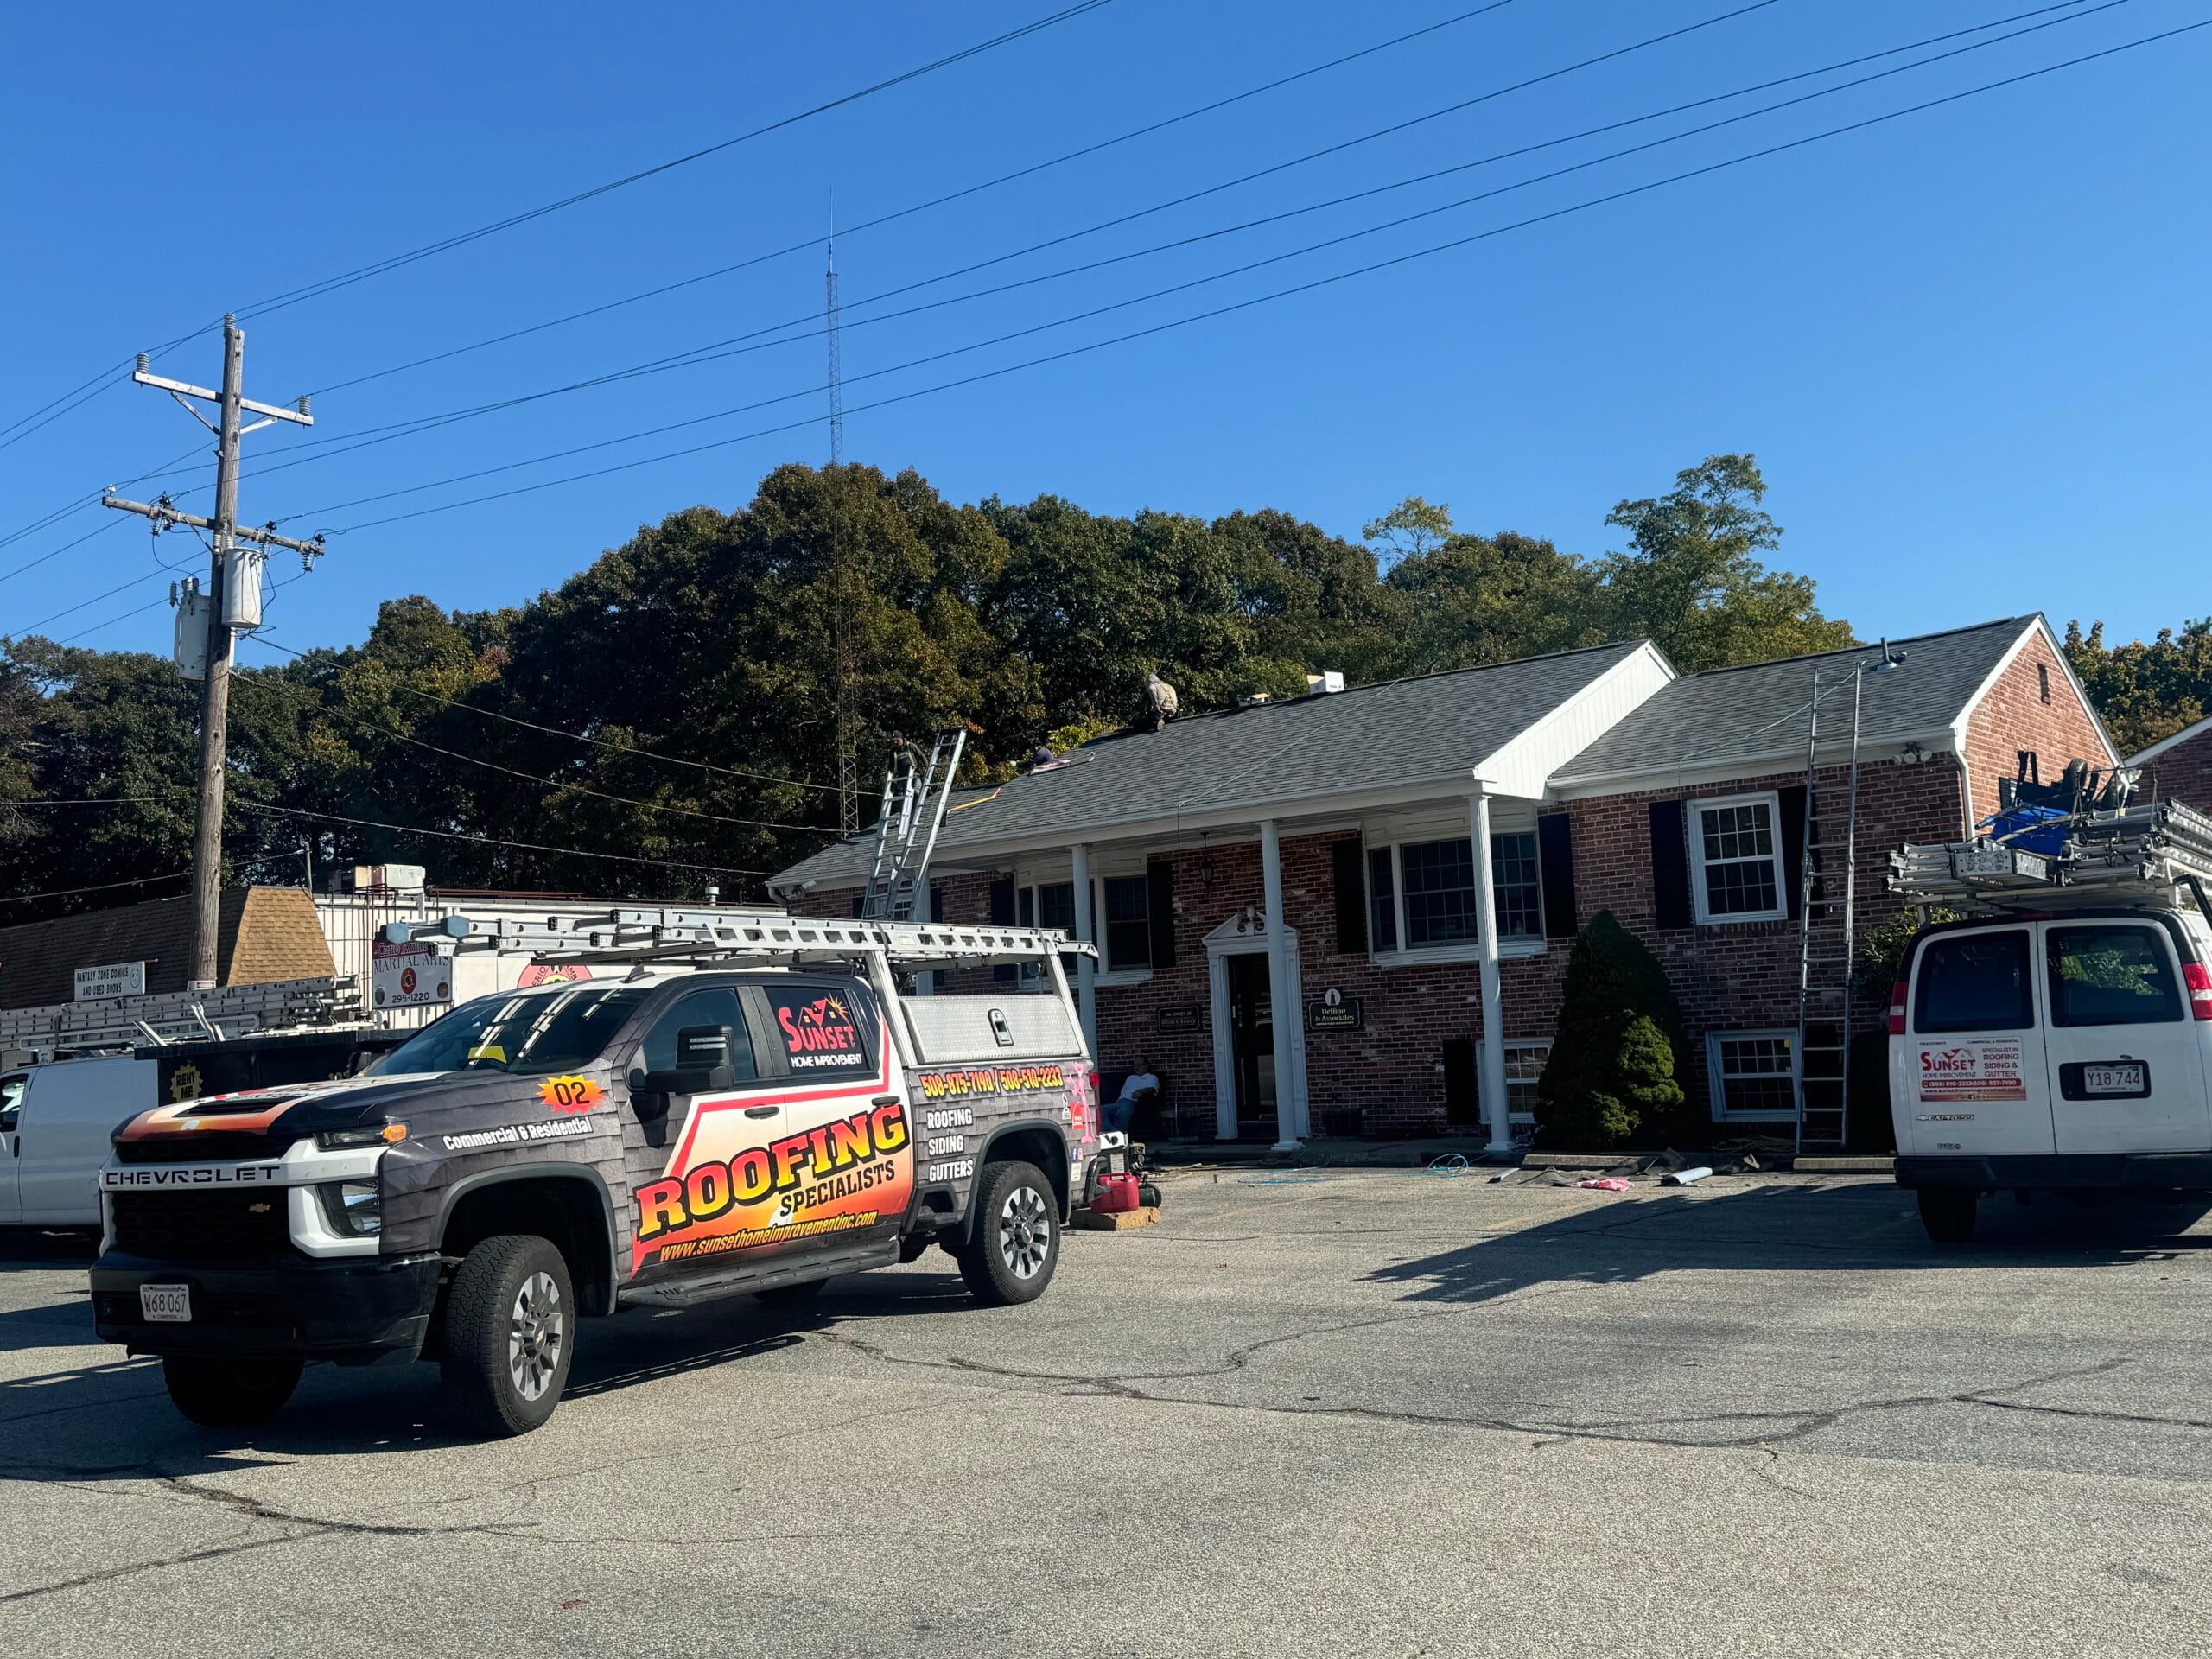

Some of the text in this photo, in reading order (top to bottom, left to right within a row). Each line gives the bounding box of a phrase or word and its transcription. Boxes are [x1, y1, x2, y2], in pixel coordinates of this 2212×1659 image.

[76, 967, 129, 982] FANTASY ZONE COMICS
[374, 955, 419, 975] MARTIAL
[82, 982, 122, 996] AND USED BOOKS
[391, 992, 429, 1003] 295-1220
[778, 1007, 855, 1052] SUNSET
[791, 1053, 862, 1068] HOME IMPROVEMENT
[1920, 1051, 1976, 1071] SUNSET
[175, 1071, 195, 1086] RENT
[919, 1071, 995, 1098] 508-875-7190
[1000, 1065, 1065, 1091] 508-510-2233
[181, 1084, 194, 1099] ME
[553, 1081, 590, 1106] 02
[926, 1108, 974, 1130] ROOFING
[442, 1125, 520, 1151] Commercial
[527, 1116, 593, 1141] Residential
[928, 1134, 964, 1156] SIDING
[105, 1166, 281, 1185] CHEVROLET
[633, 1104, 910, 1242] ROOFING
[928, 1159, 975, 1182] GUTTERS
[779, 1160, 895, 1217] SPECIALISTS
[659, 1210, 879, 1262] www.sunsethomeimprovementinc.com
